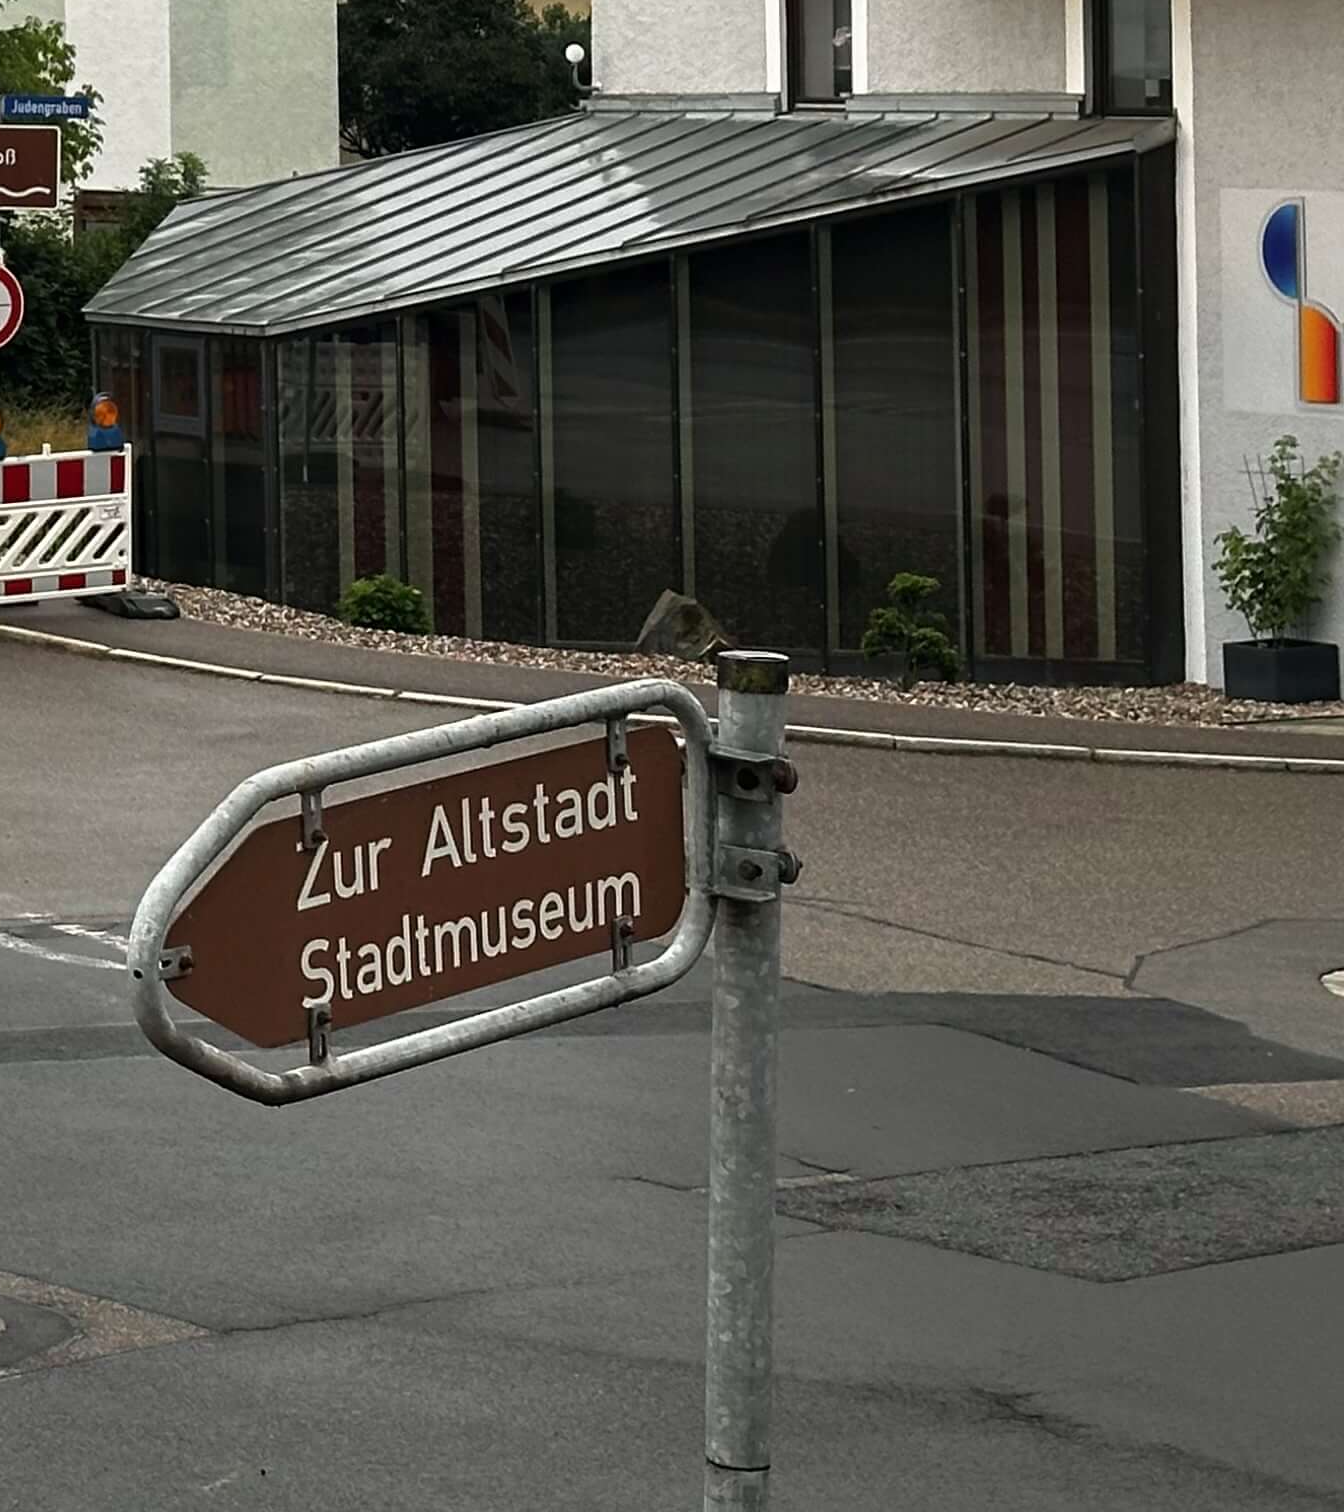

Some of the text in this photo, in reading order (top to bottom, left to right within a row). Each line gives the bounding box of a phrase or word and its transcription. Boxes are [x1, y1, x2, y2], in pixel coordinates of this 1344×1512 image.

[11, 99, 82, 118] Judengraben
[296, 764, 639, 912] Zur Altstadt
[300, 871, 642, 1009] Stadtmuseum
